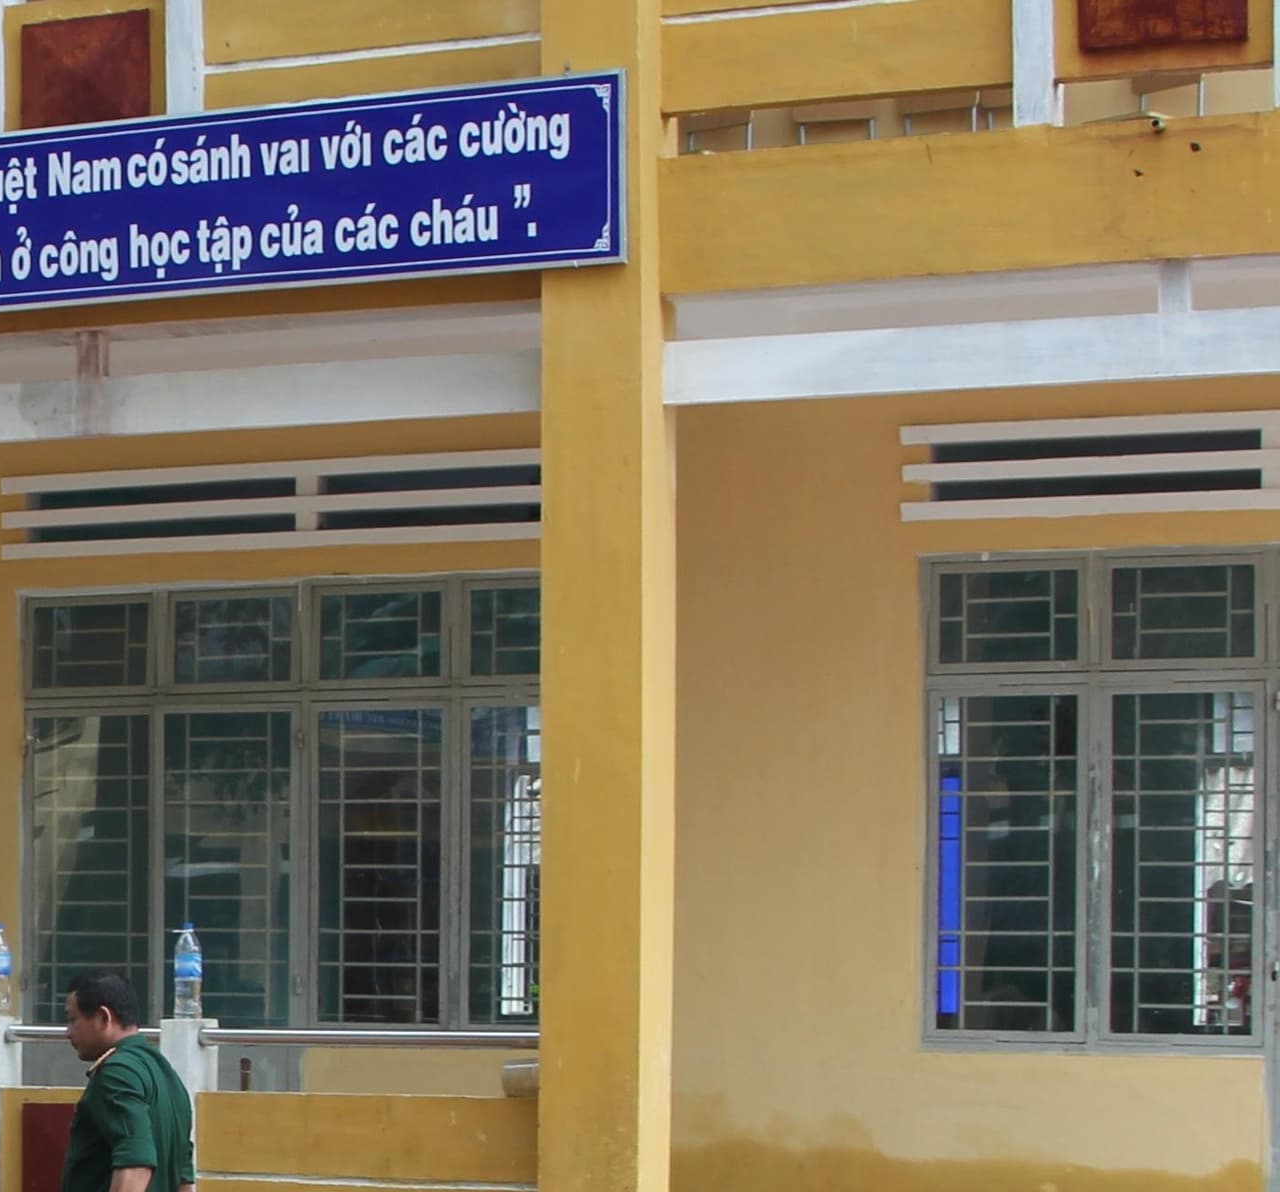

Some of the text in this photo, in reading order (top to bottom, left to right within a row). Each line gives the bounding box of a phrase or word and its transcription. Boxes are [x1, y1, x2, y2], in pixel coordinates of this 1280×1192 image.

[49, 152, 122, 196] Nam
[384, 113, 446, 164] các
[459, 103, 570, 158] cường
[12, 226, 32, 279] ở
[40, 231, 119, 280] công
[130, 224, 190, 278] học
[197, 217, 252, 272] tập
[261, 205, 323, 257] của
[336, 203, 398, 251] các
